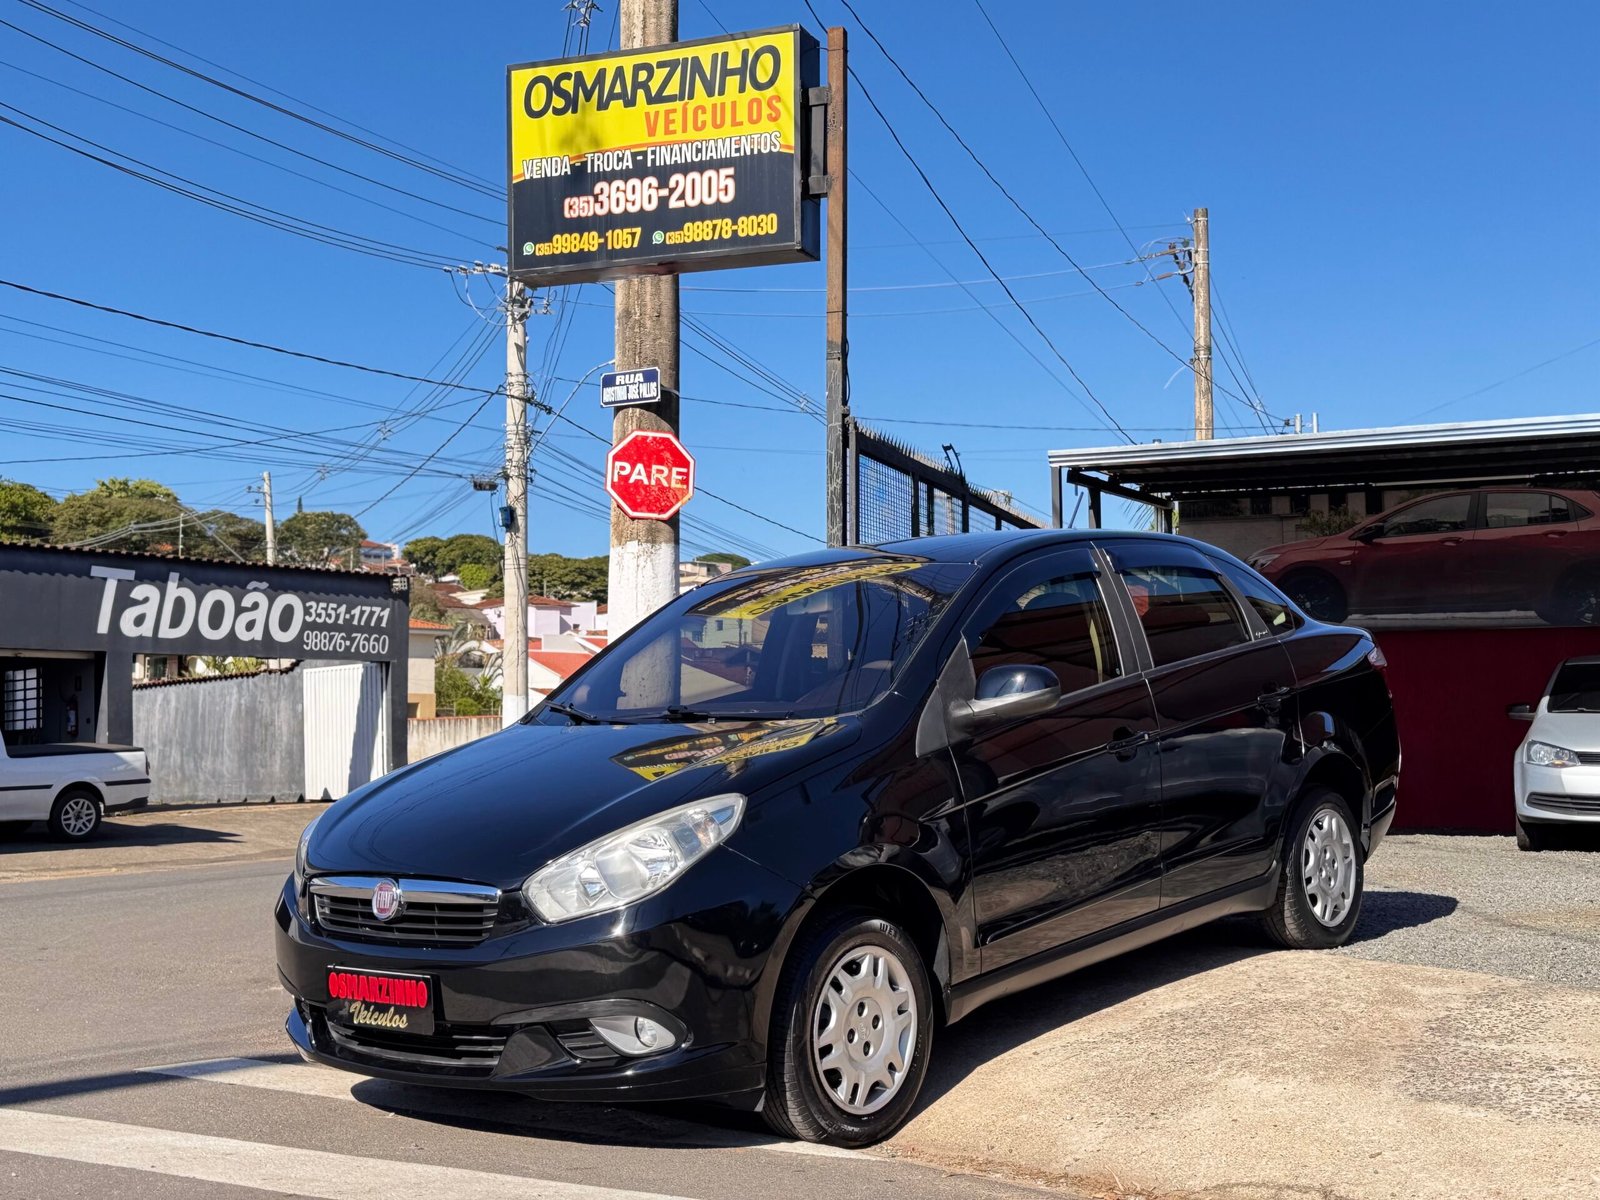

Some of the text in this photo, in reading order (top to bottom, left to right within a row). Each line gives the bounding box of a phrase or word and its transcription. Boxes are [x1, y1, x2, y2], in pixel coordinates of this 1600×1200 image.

[523, 44, 781, 119] OSMARZINHO
[644, 94, 782, 138] VEÍCULOS
[522, 155, 572, 180] VENDA
[584, 149, 633, 174] TROCA
[646, 131, 781, 168] FINANCIAMENTOS
[563, 166, 736, 219] (35)3696-2005
[615, 372, 644, 386] RUA
[613, 461, 688, 490] PARE
[90, 565, 305, 643] Taboão
[304, 600, 391, 628] 3551-1771
[302, 630, 390, 655] 98876-7660
[328, 971, 428, 1009] OSMARZINHO
